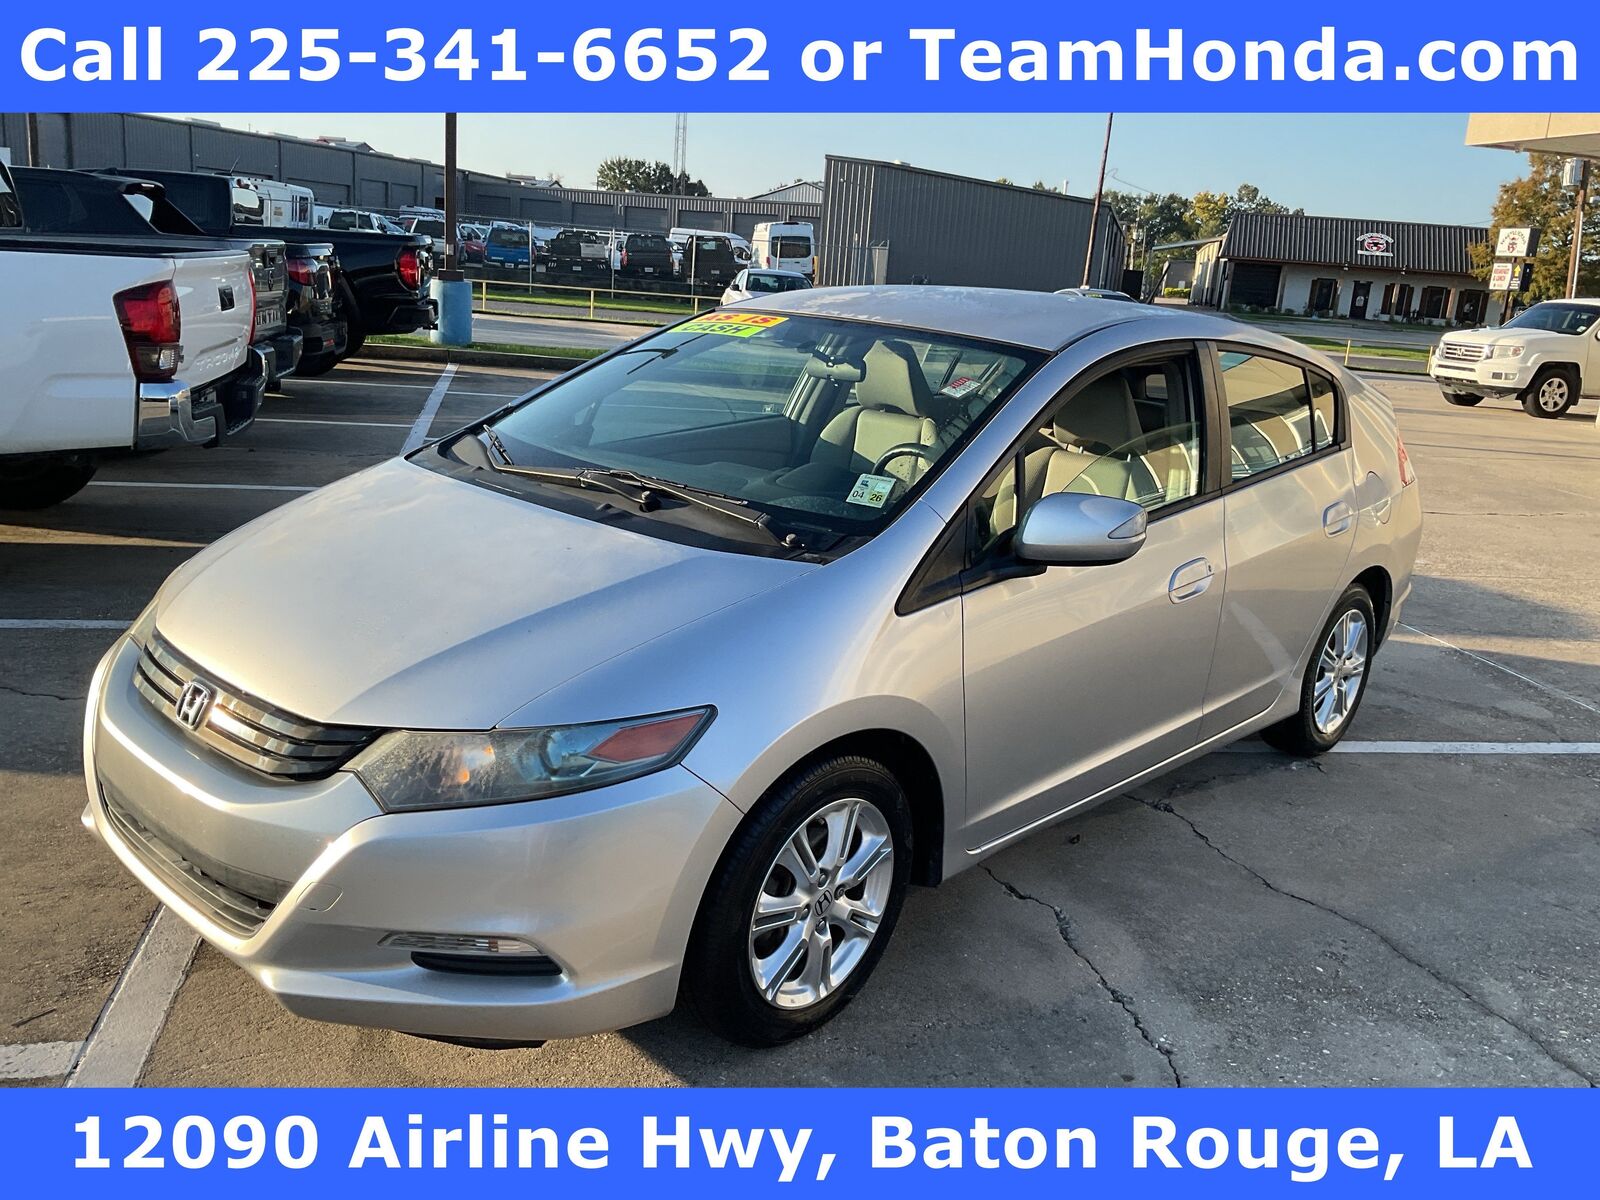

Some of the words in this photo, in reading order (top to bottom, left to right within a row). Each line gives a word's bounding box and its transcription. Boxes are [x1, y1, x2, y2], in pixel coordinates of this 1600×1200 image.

[681, 322, 746, 334] CASH
[852, 490, 865, 499] 04
[869, 493, 883, 502] 26
